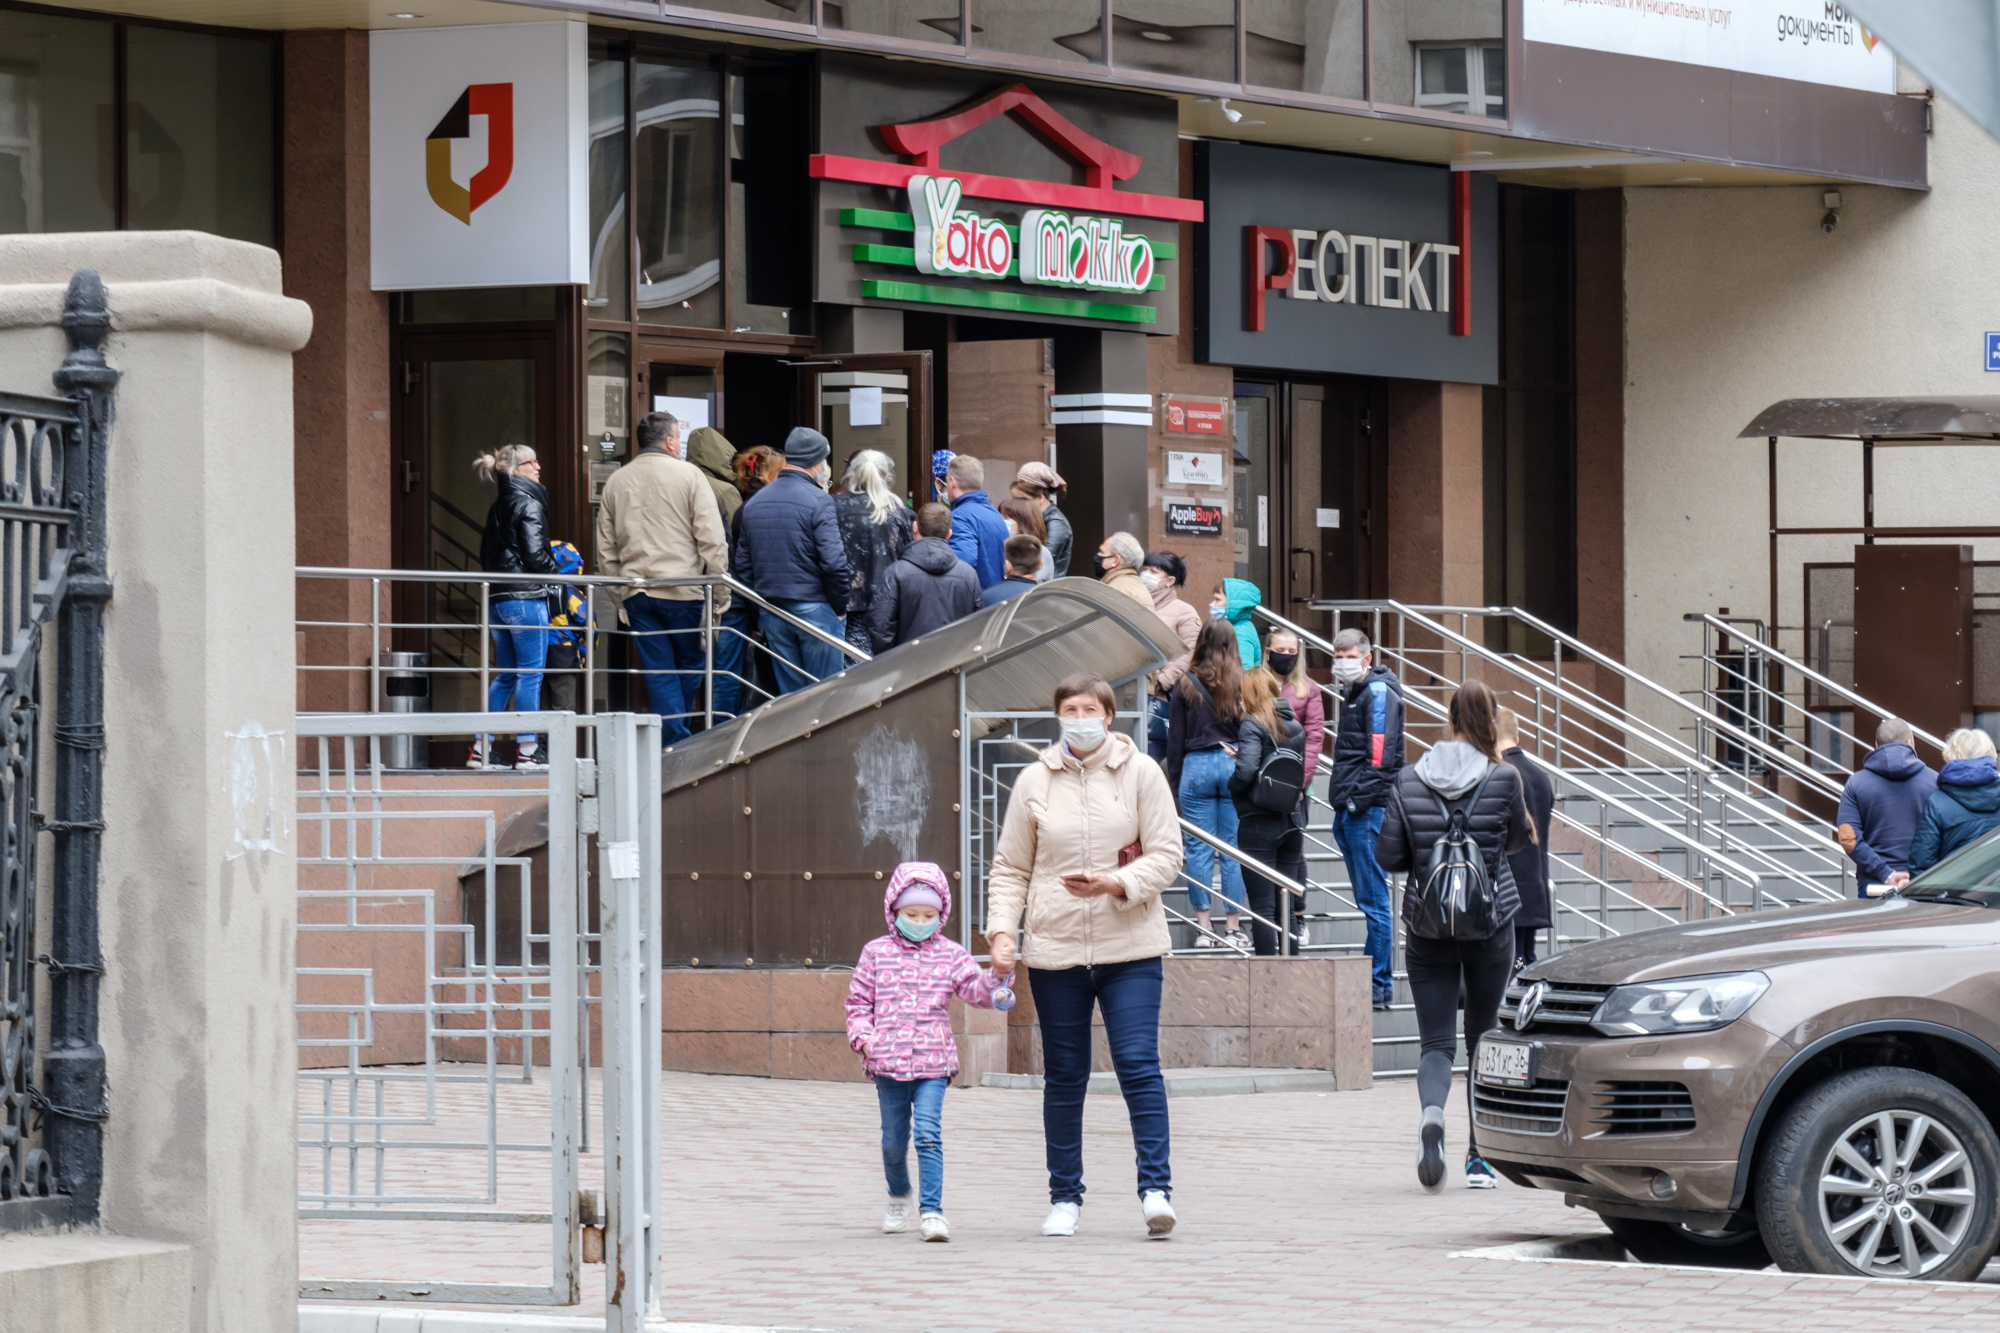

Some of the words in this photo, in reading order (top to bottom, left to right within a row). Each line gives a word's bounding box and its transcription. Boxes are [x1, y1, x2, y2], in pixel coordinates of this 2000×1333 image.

[1708, 8, 1732, 30] услуг
[1778, 14, 1853, 46] документы
[1246, 225, 1460, 331] РЕСПЕКТ
[1170, 505, 1213, 525] AppleBuy
